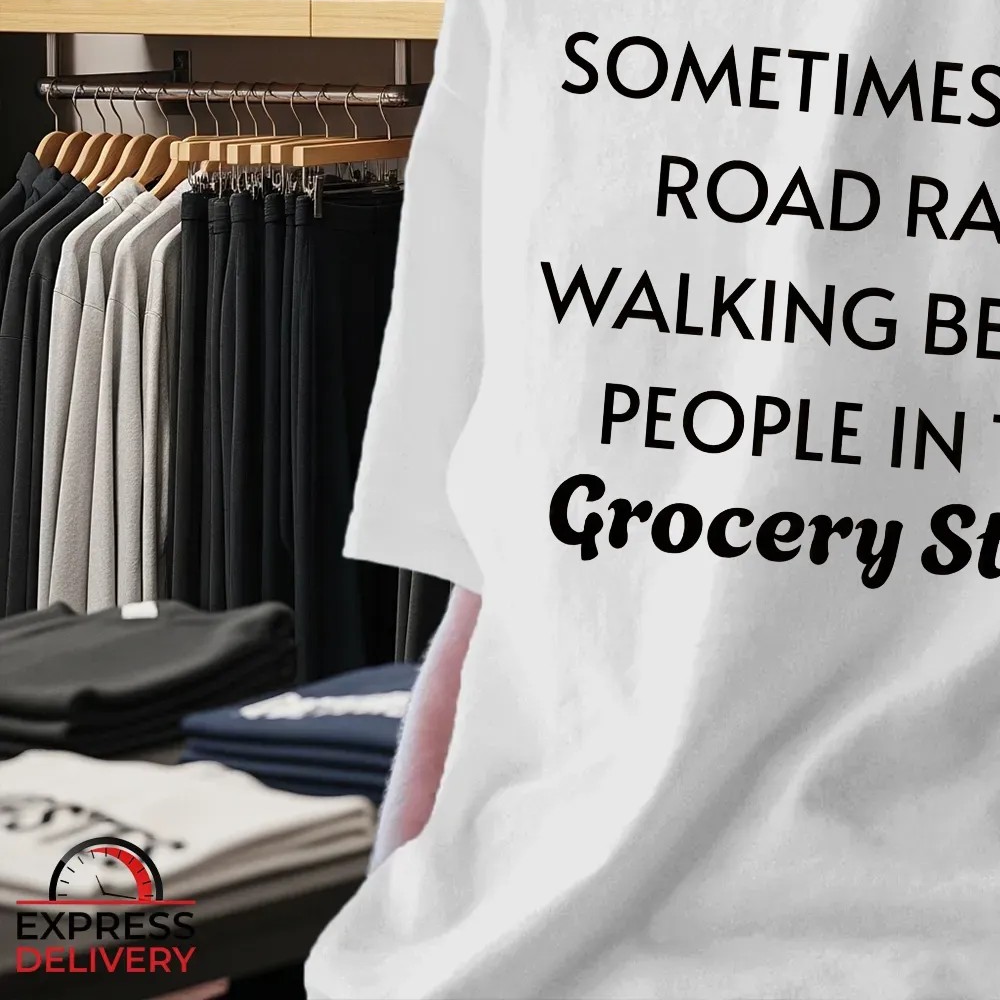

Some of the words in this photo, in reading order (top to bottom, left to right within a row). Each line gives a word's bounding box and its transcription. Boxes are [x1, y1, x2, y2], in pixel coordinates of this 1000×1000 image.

[656, 154, 881, 232] ROAD
[540, 261, 898, 351] WALKING
[600, 382, 864, 466] PEOPLE
[890, 406, 966, 474] IN
[548, 473, 904, 590] Grocery
